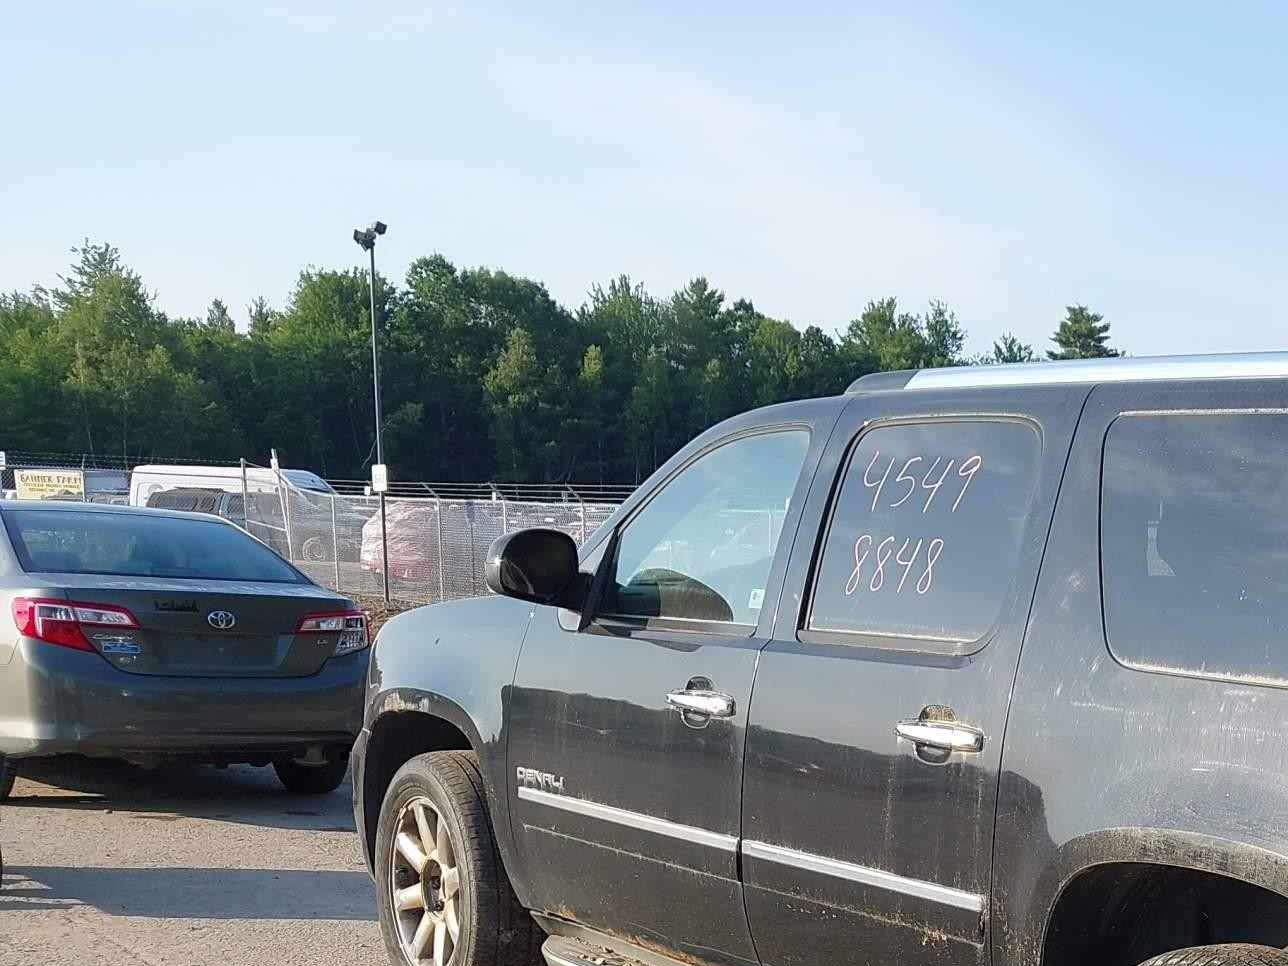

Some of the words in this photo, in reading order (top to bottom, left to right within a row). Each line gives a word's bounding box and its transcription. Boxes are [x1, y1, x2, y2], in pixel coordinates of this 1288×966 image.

[863, 450, 982, 514] 4549
[845, 534, 944, 596] 8848
[516, 766, 565, 789] DENALI
